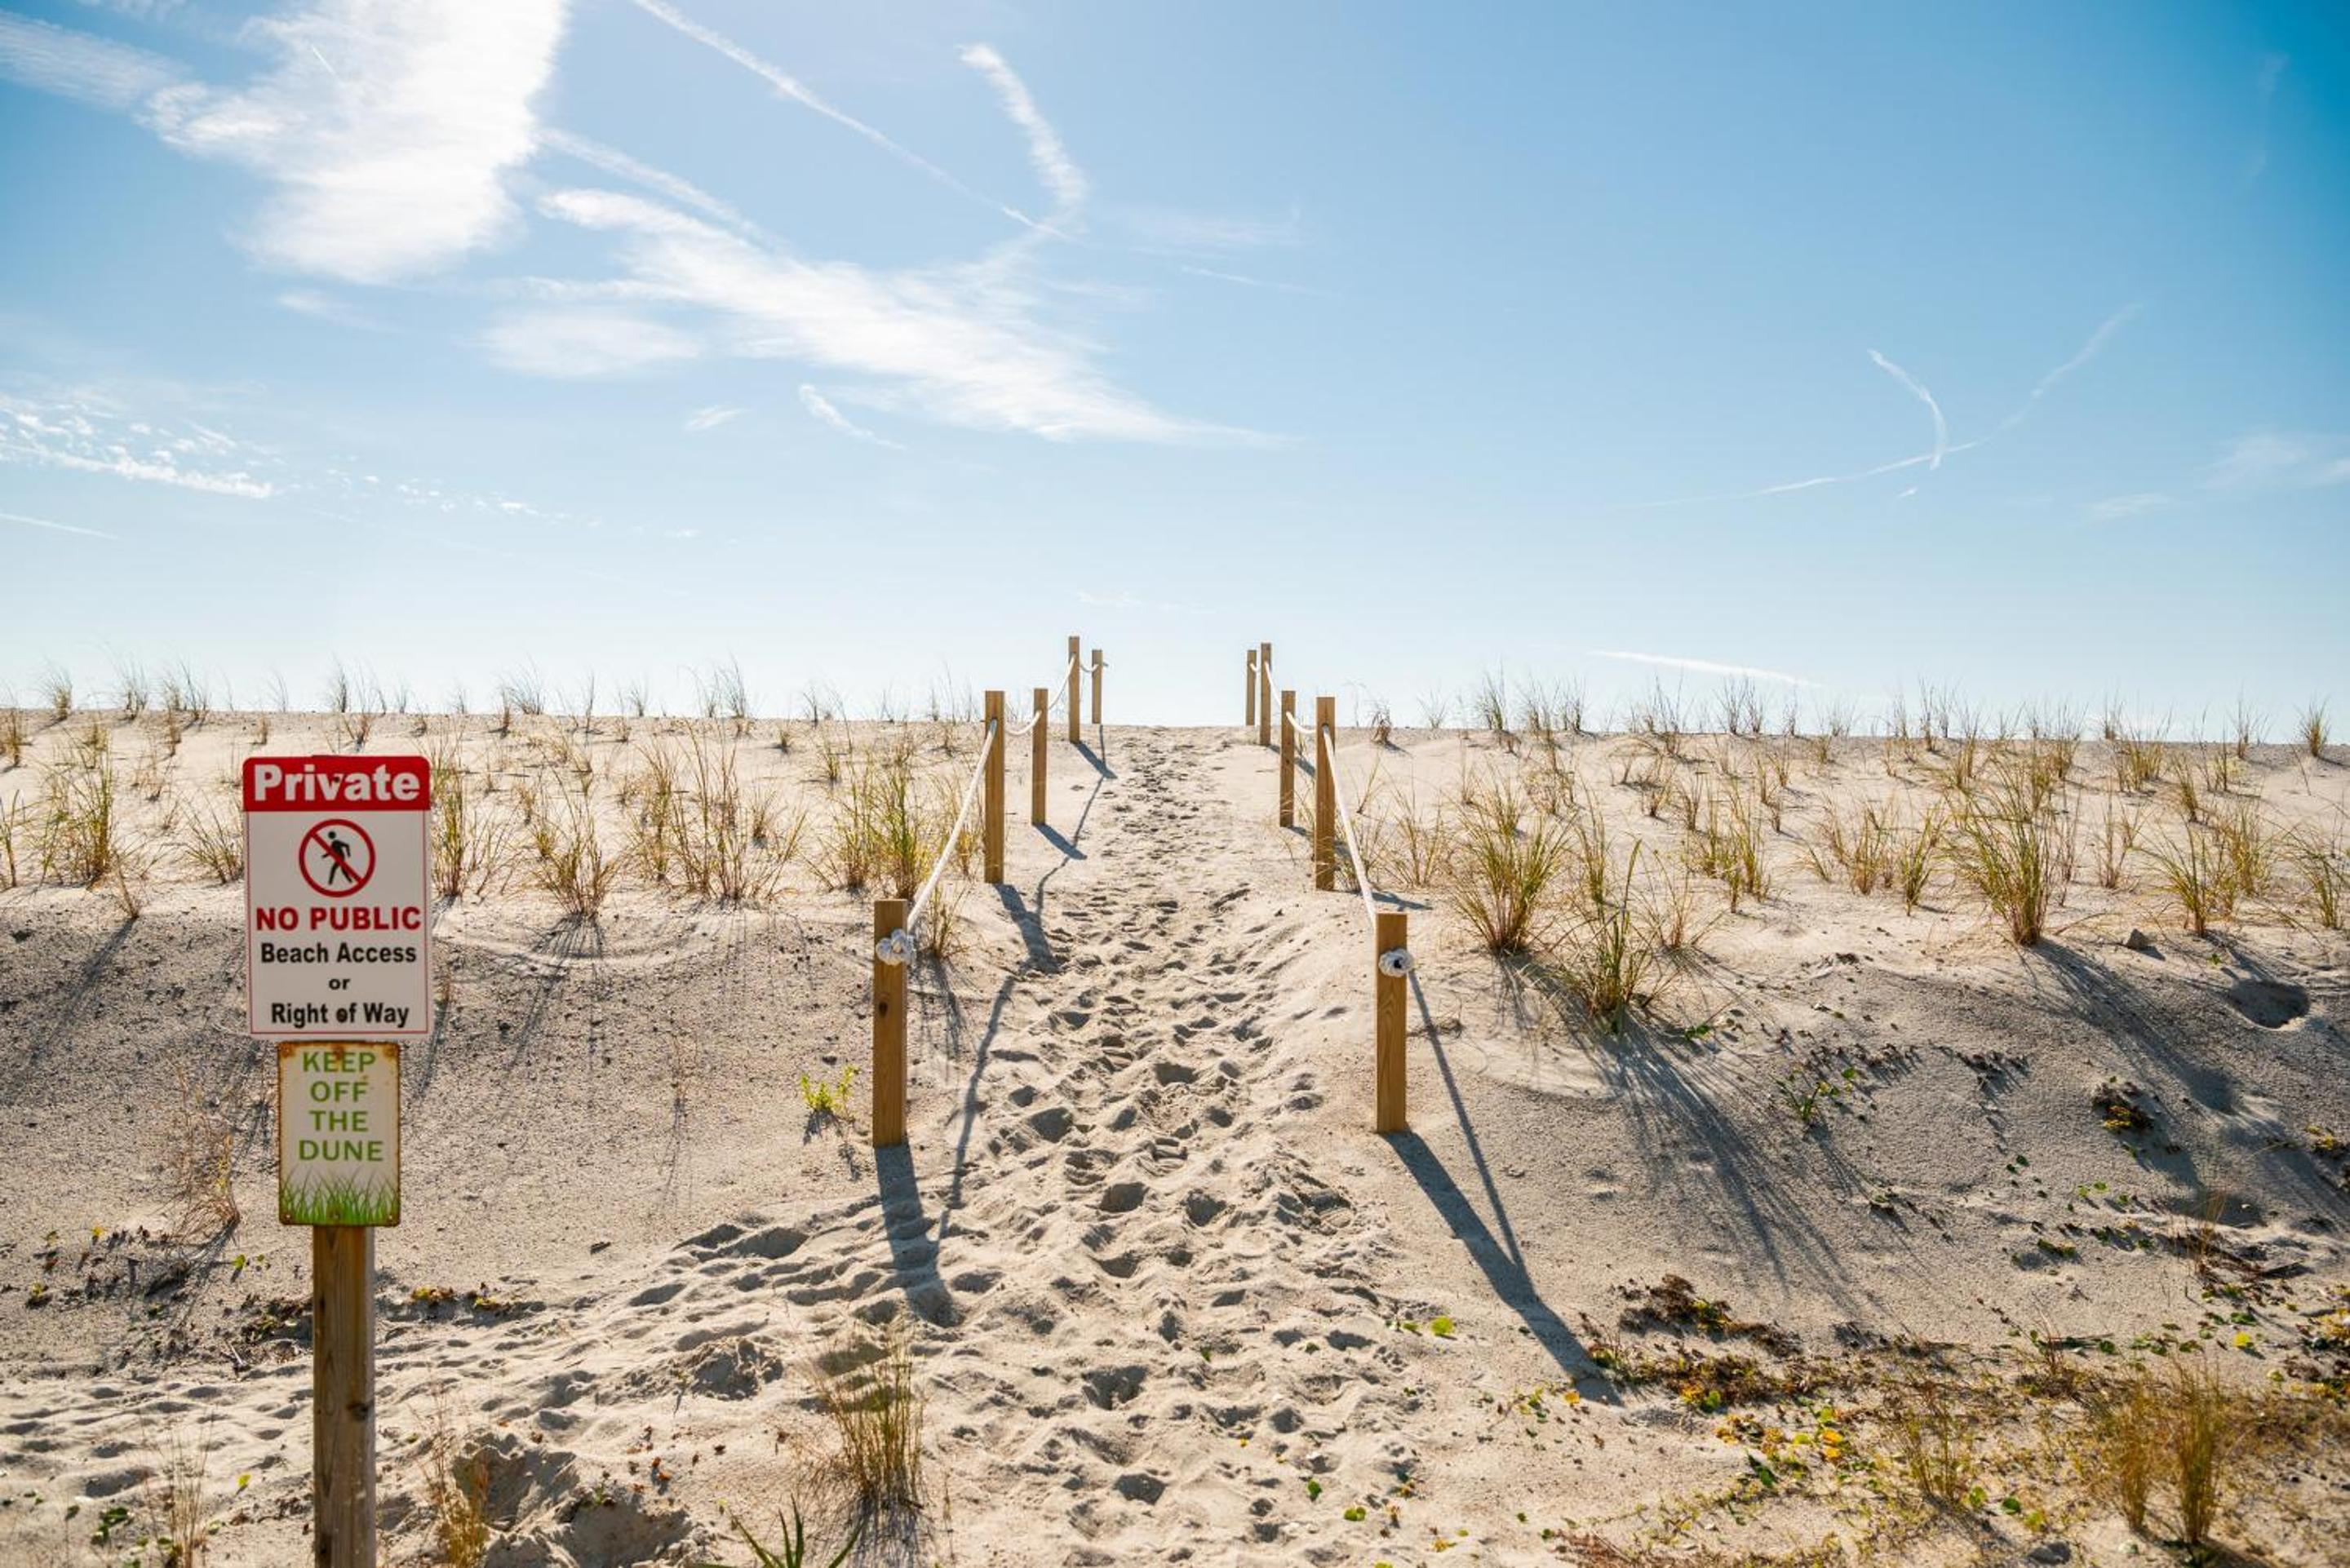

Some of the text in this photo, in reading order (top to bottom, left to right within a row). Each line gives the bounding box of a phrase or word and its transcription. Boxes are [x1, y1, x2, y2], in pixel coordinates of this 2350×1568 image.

[254, 764, 420, 801] Private
[256, 906, 422, 930] NO PUBLIC
[261, 942, 417, 963] Beach Access
[329, 978, 351, 990] or
[271, 1003, 410, 1028] Right of Way
[303, 1052, 376, 1073] KEEP
[310, 1081, 370, 1102] OFF
[308, 1110, 369, 1132] THE
[299, 1140, 384, 1162] DUNE
